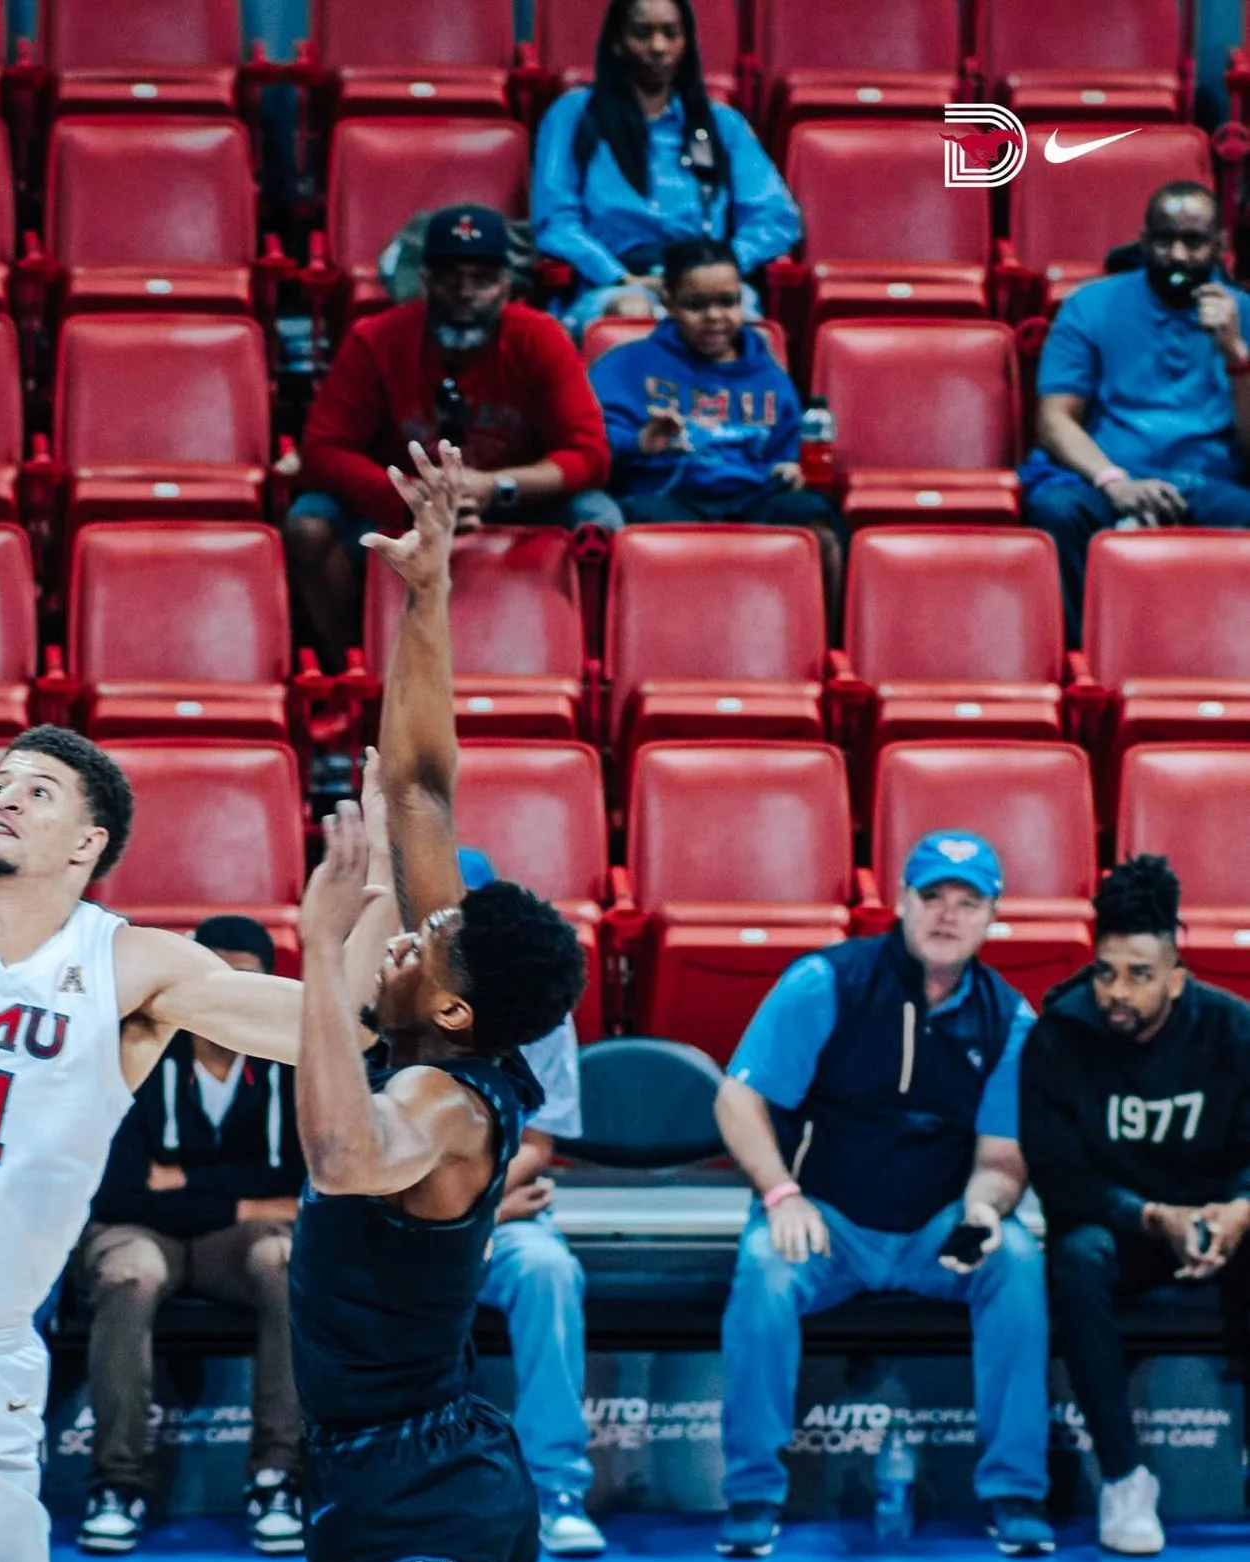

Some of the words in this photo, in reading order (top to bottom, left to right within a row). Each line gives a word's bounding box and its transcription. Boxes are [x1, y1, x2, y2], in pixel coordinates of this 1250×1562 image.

[1107, 1091, 1205, 1143] 1977
[583, 1398, 648, 1424] UTO
[803, 1404, 891, 1428] AUTO
[787, 1428, 886, 1454] SCOPE
